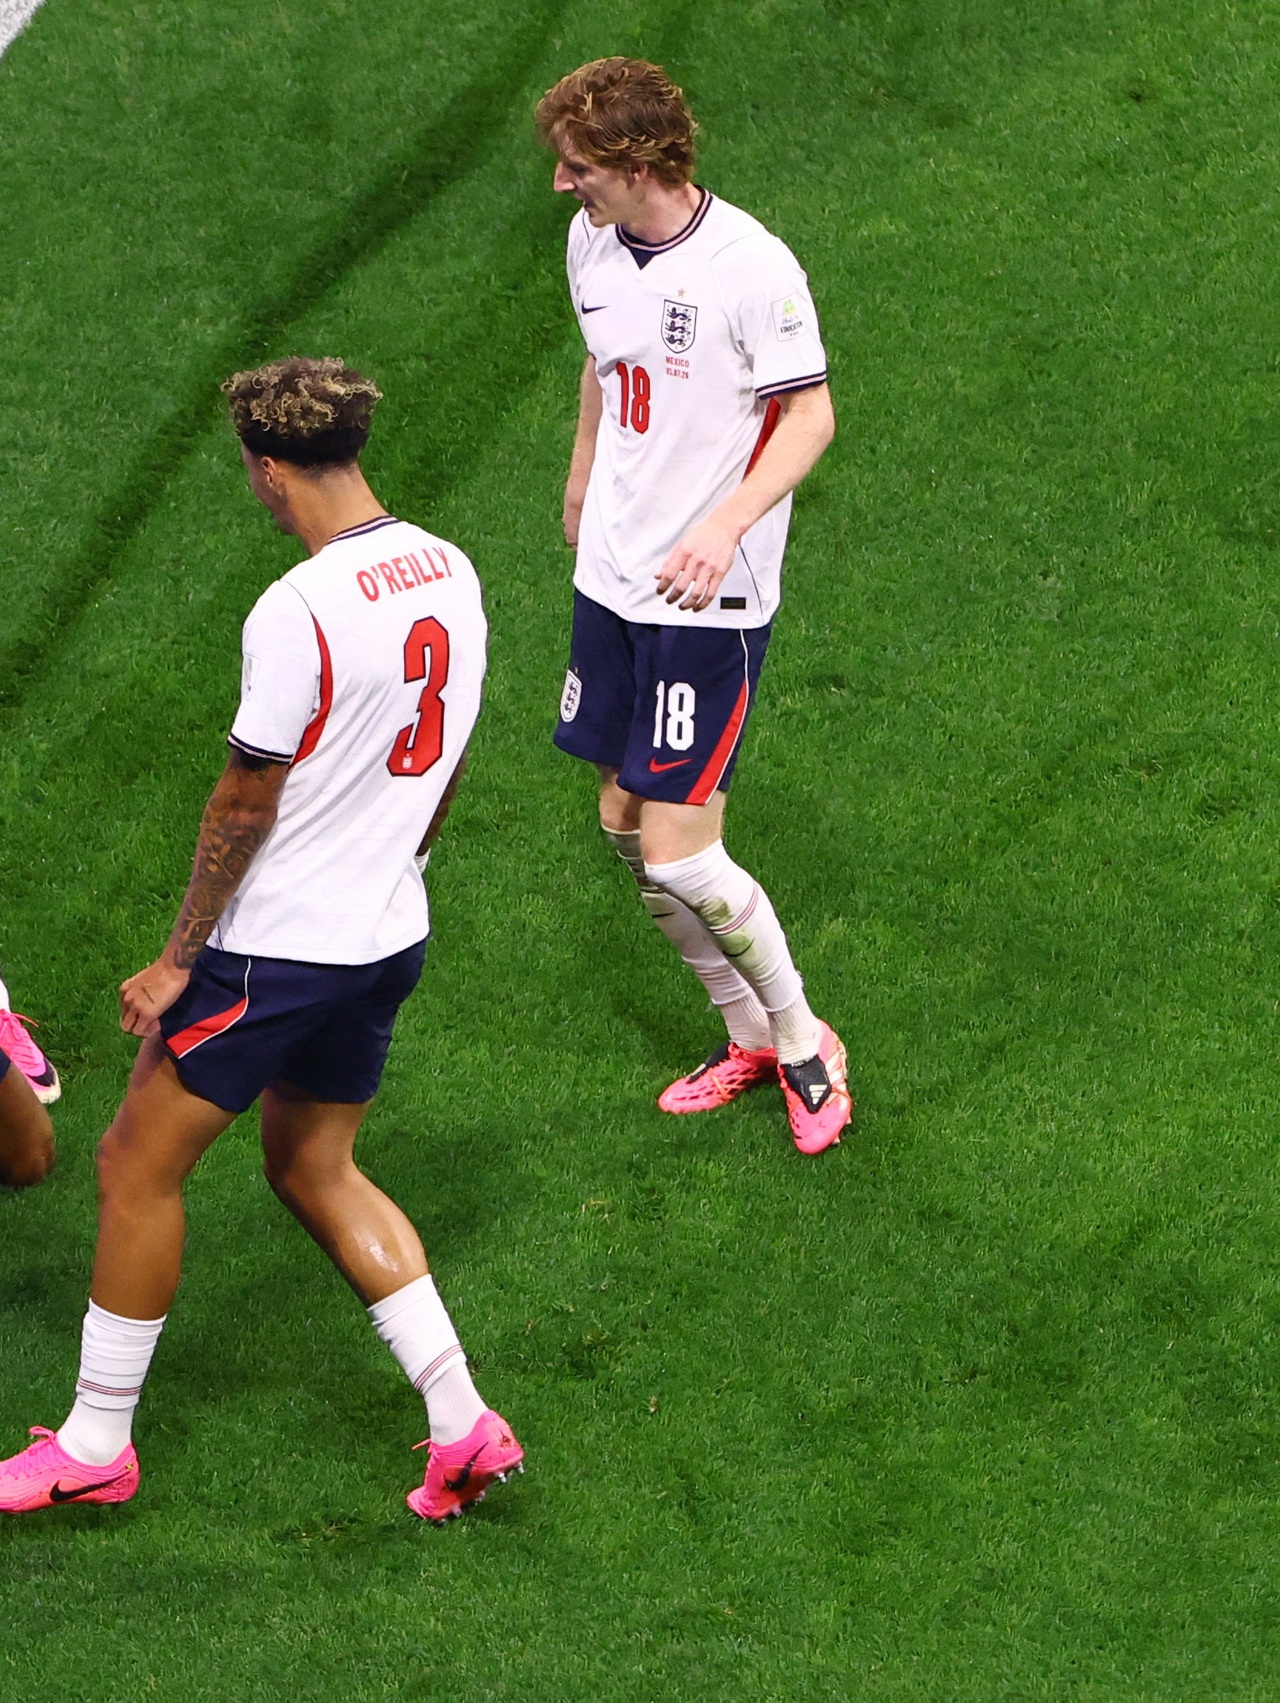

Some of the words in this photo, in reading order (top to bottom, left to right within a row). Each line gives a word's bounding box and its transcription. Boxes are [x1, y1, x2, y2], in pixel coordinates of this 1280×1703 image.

[615, 361, 650, 434] 18
[665, 356, 690, 368] MEXICO
[356, 547, 452, 601] O'REILLY
[386, 615, 450, 777] 3
[653, 680, 696, 751] 18
